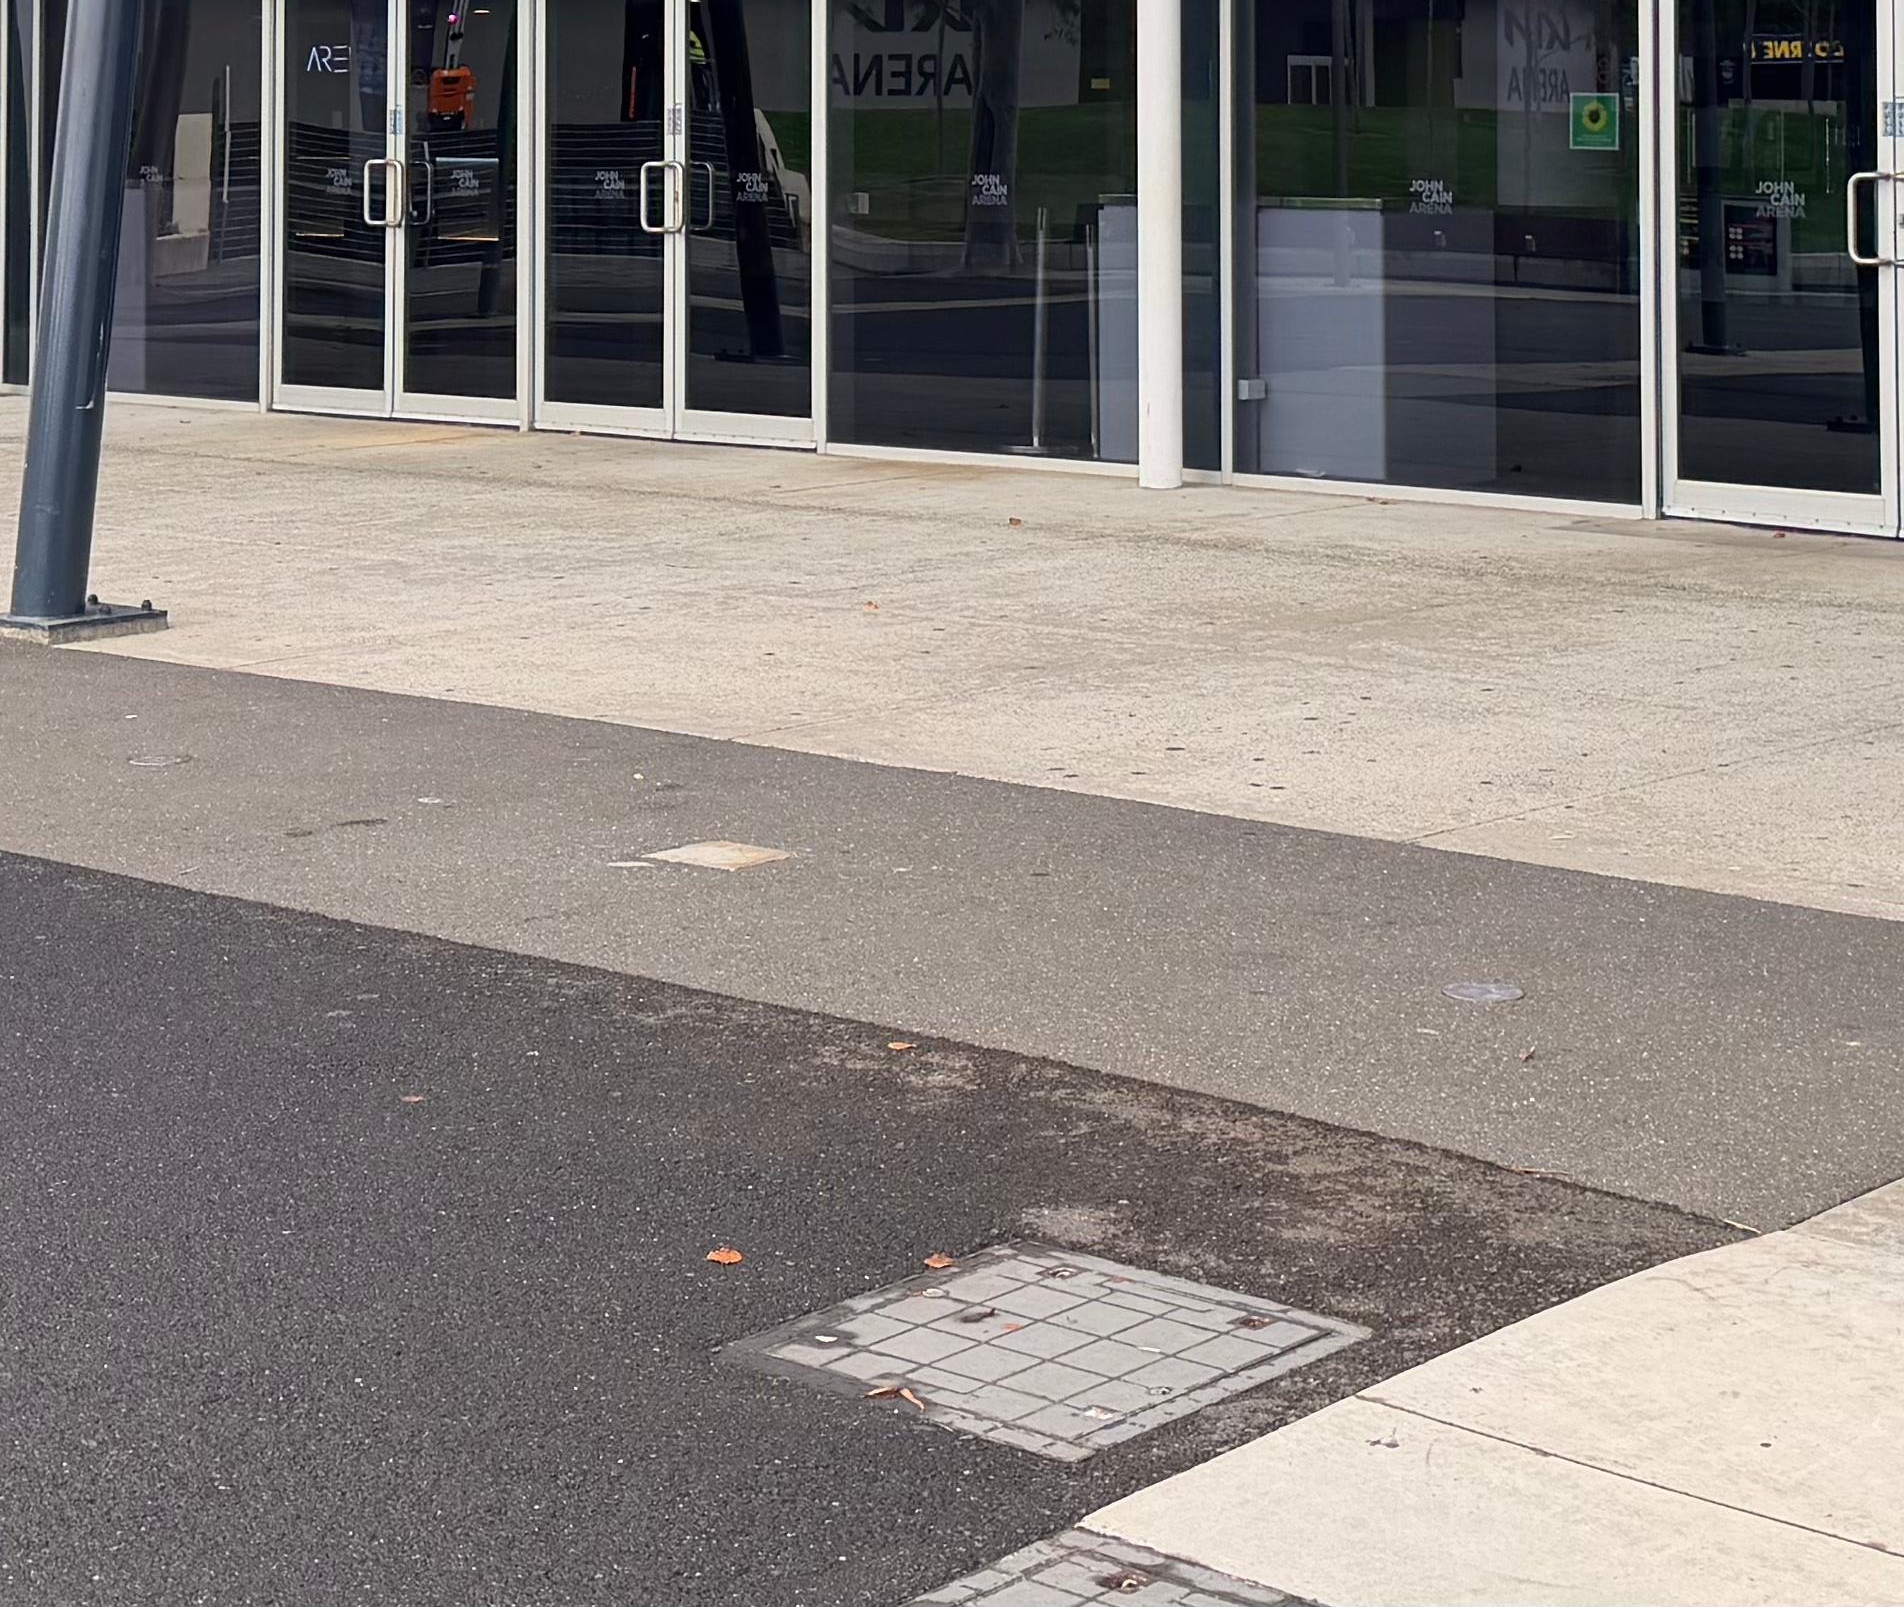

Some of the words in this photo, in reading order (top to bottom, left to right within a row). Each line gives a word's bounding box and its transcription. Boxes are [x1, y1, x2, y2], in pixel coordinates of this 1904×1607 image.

[737, 173, 761, 183] JOHN
[972, 175, 1000, 185] JOHN
[982, 185, 1007, 194] CAIN
[1409, 180, 1443, 192] JOHN
[1755, 181, 1794, 194] JOHN
[1422, 192, 1452, 203] CAIN
[1771, 194, 1805, 206] CAIN
[1409, 203, 1452, 214] ARENA
[1756, 205, 1806, 218] ARENA
